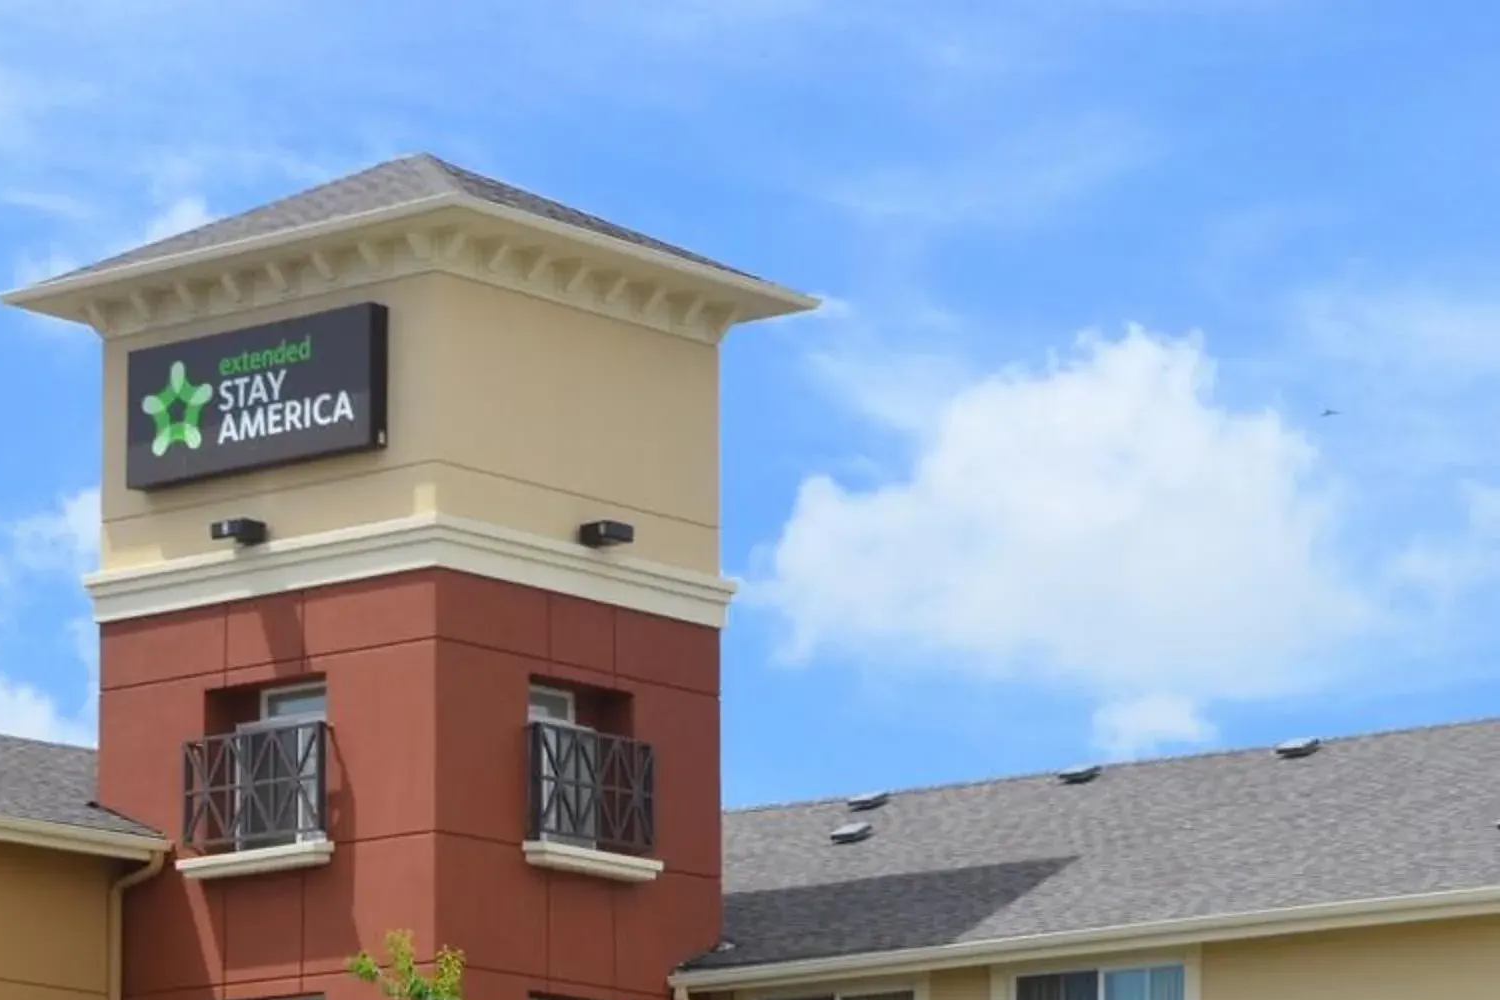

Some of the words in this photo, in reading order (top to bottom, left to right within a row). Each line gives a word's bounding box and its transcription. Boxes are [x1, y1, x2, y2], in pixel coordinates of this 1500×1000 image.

[219, 334, 311, 375] extended
[218, 369, 287, 412] STAY
[217, 390, 354, 445] AMERICA
